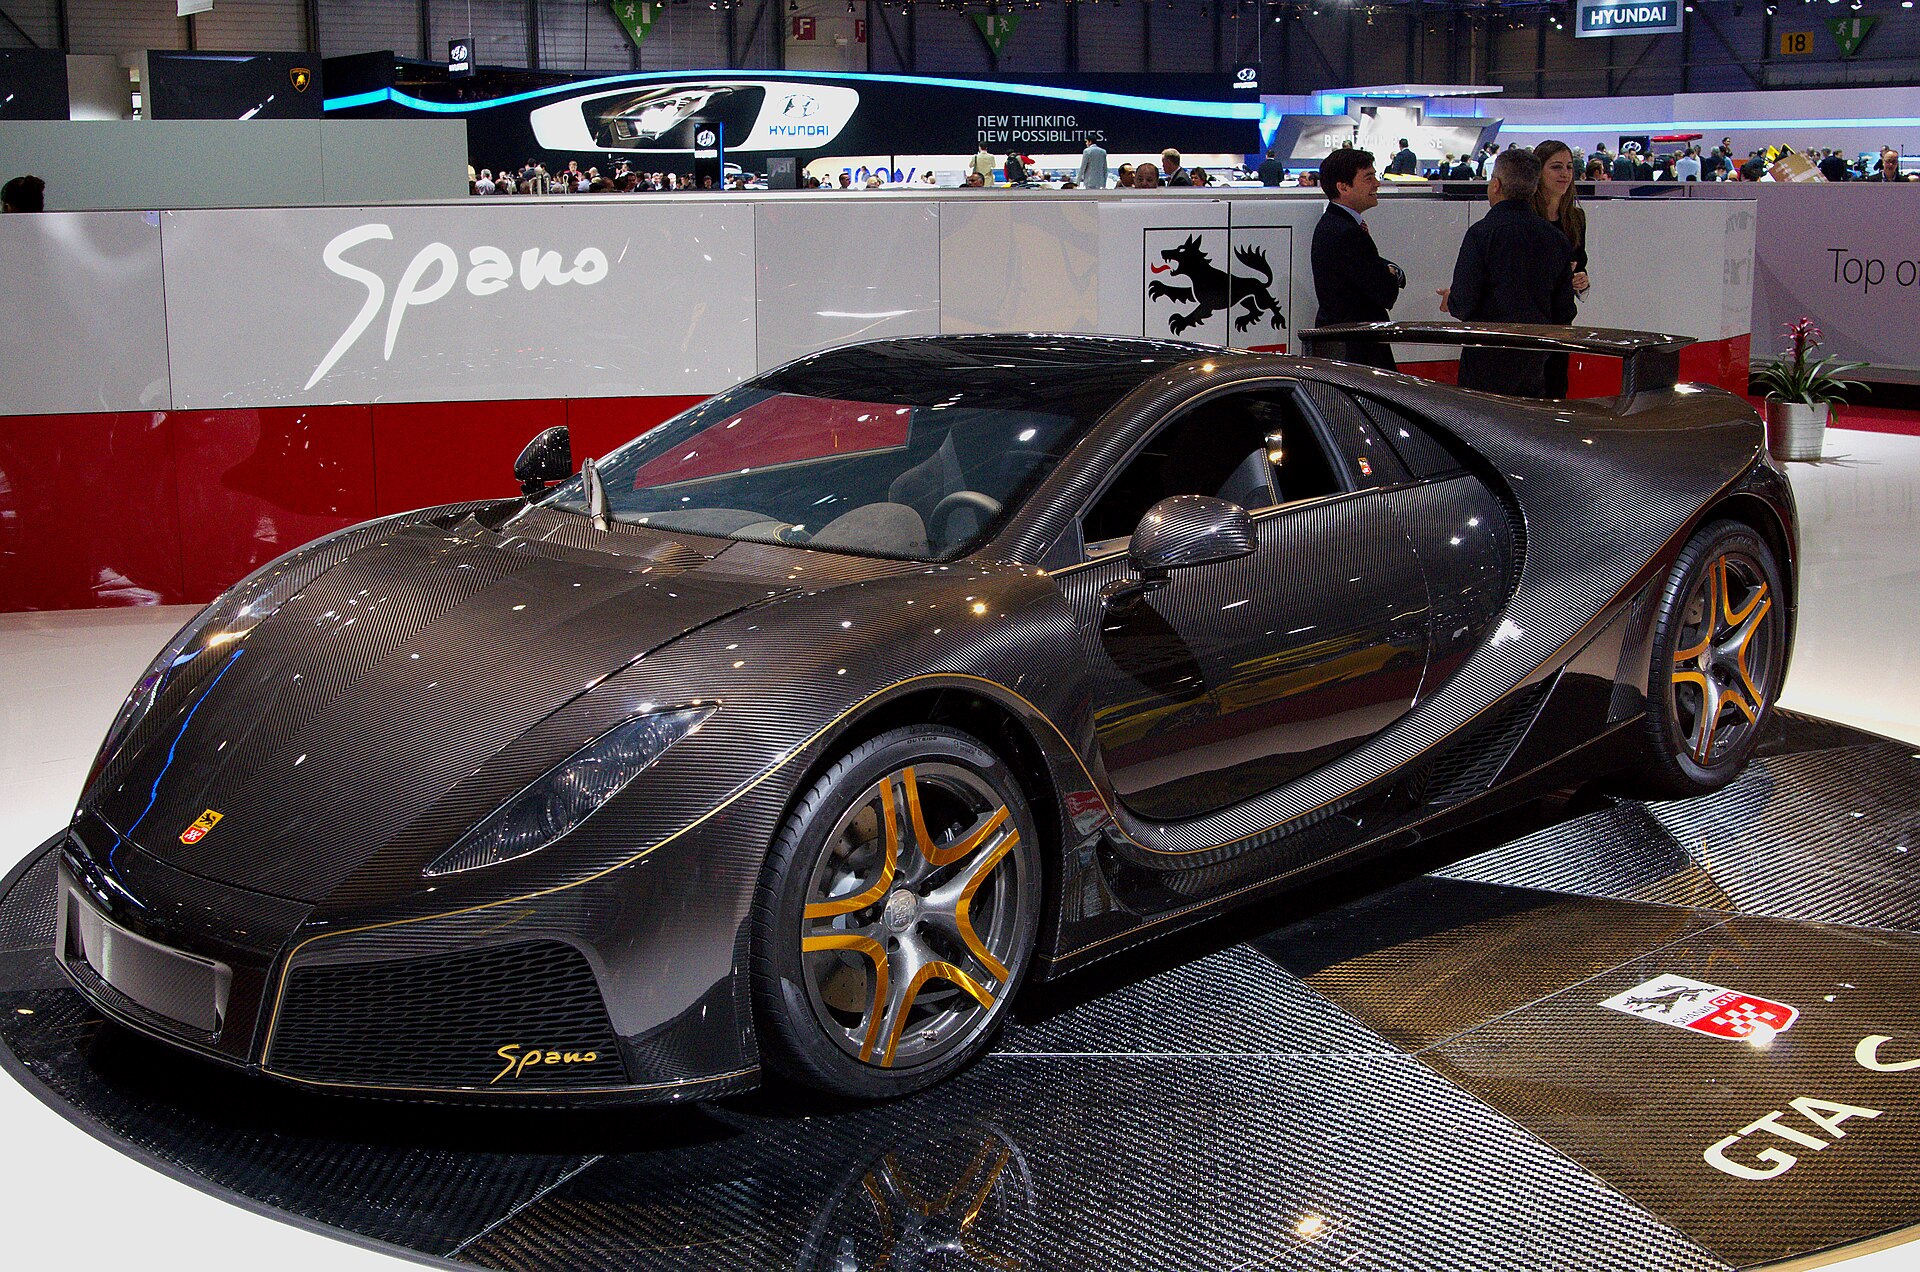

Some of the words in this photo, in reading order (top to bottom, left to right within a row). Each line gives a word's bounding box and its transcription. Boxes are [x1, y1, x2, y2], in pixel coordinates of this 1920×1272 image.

[1590, 6, 1667, 26] HYUNDAI
[799, 18, 811, 35] F
[1787, 33, 1806, 53] 18
[769, 125, 829, 136] HYUNDAI
[977, 115, 1009, 127] NEW
[1012, 115, 1079, 127] THINKING.
[977, 130, 1009, 142] NEW
[1827, 248, 1885, 294] Top
[1896, 260, 1920, 287] o
[303, 223, 609, 391] Spano
[1711, 993, 1743, 1007] GTA
[489, 1043, 597, 1085] Spano
[1703, 1096, 1884, 1181] GTA
